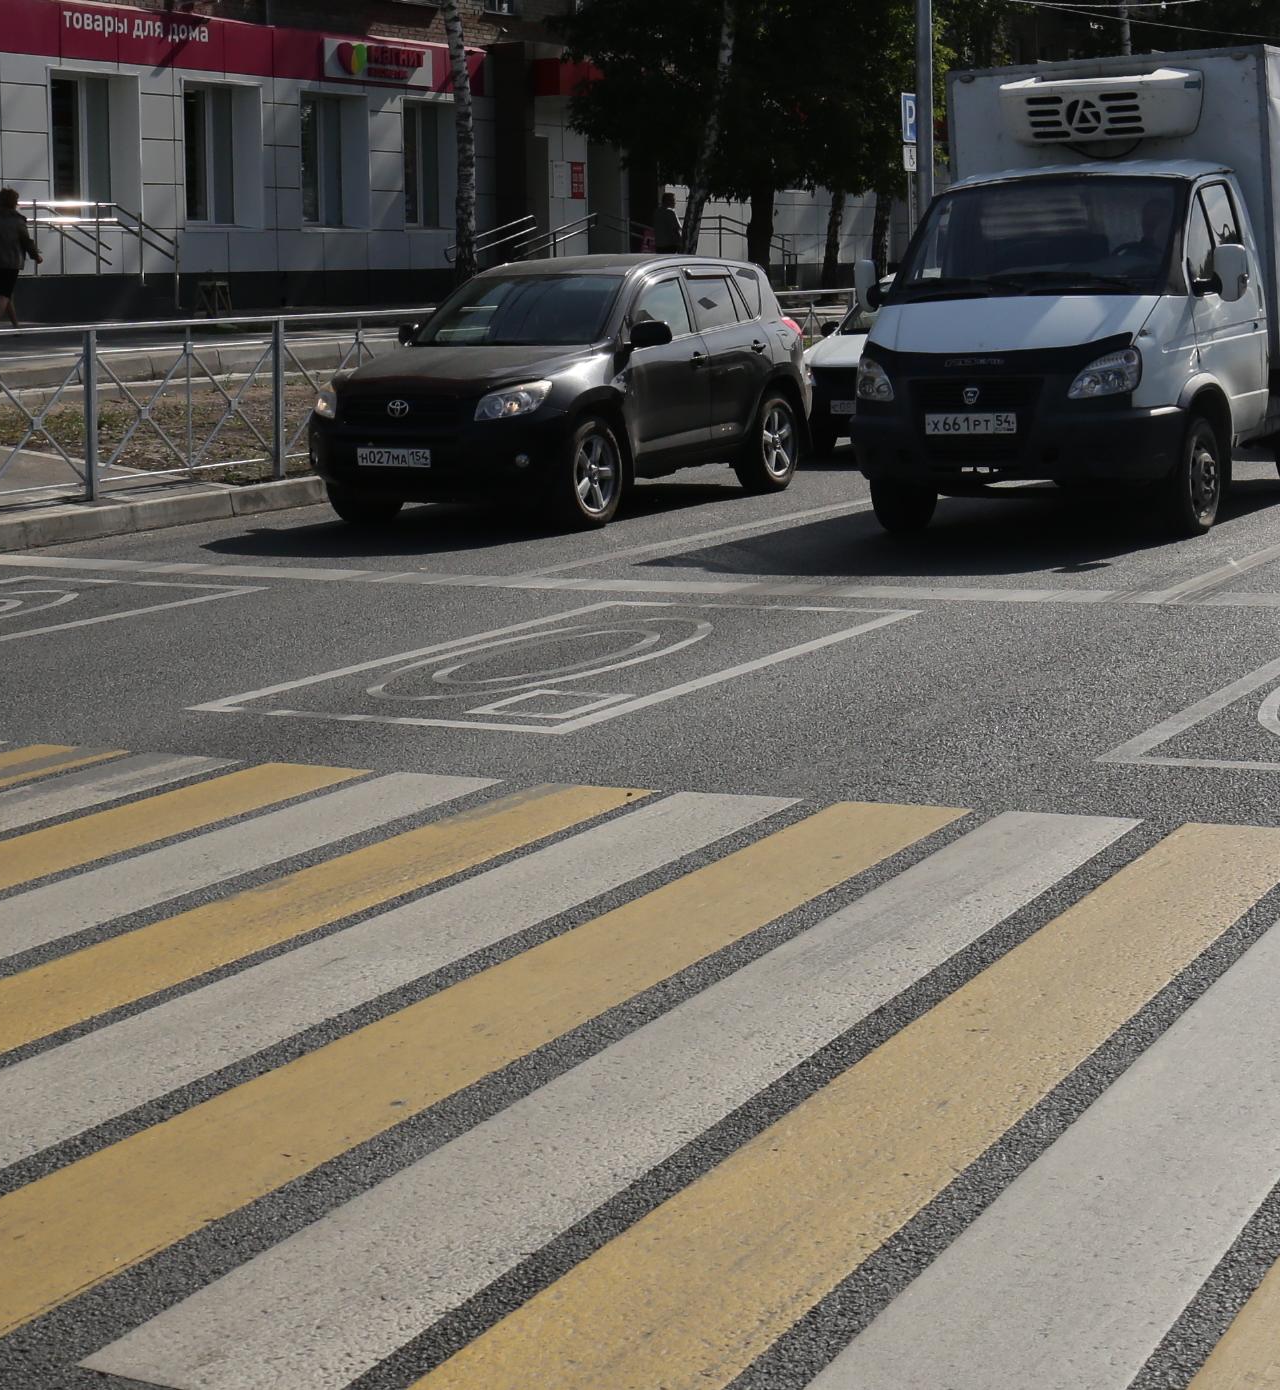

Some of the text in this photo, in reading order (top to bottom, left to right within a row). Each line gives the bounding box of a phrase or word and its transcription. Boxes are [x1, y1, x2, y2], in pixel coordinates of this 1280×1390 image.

[63, 10, 210, 43] товары для дома
[906, 100, 916, 136] P
[931, 414, 1011, 432] Х661РТ 54
[362, 451, 429, 465] Н027МА 154
